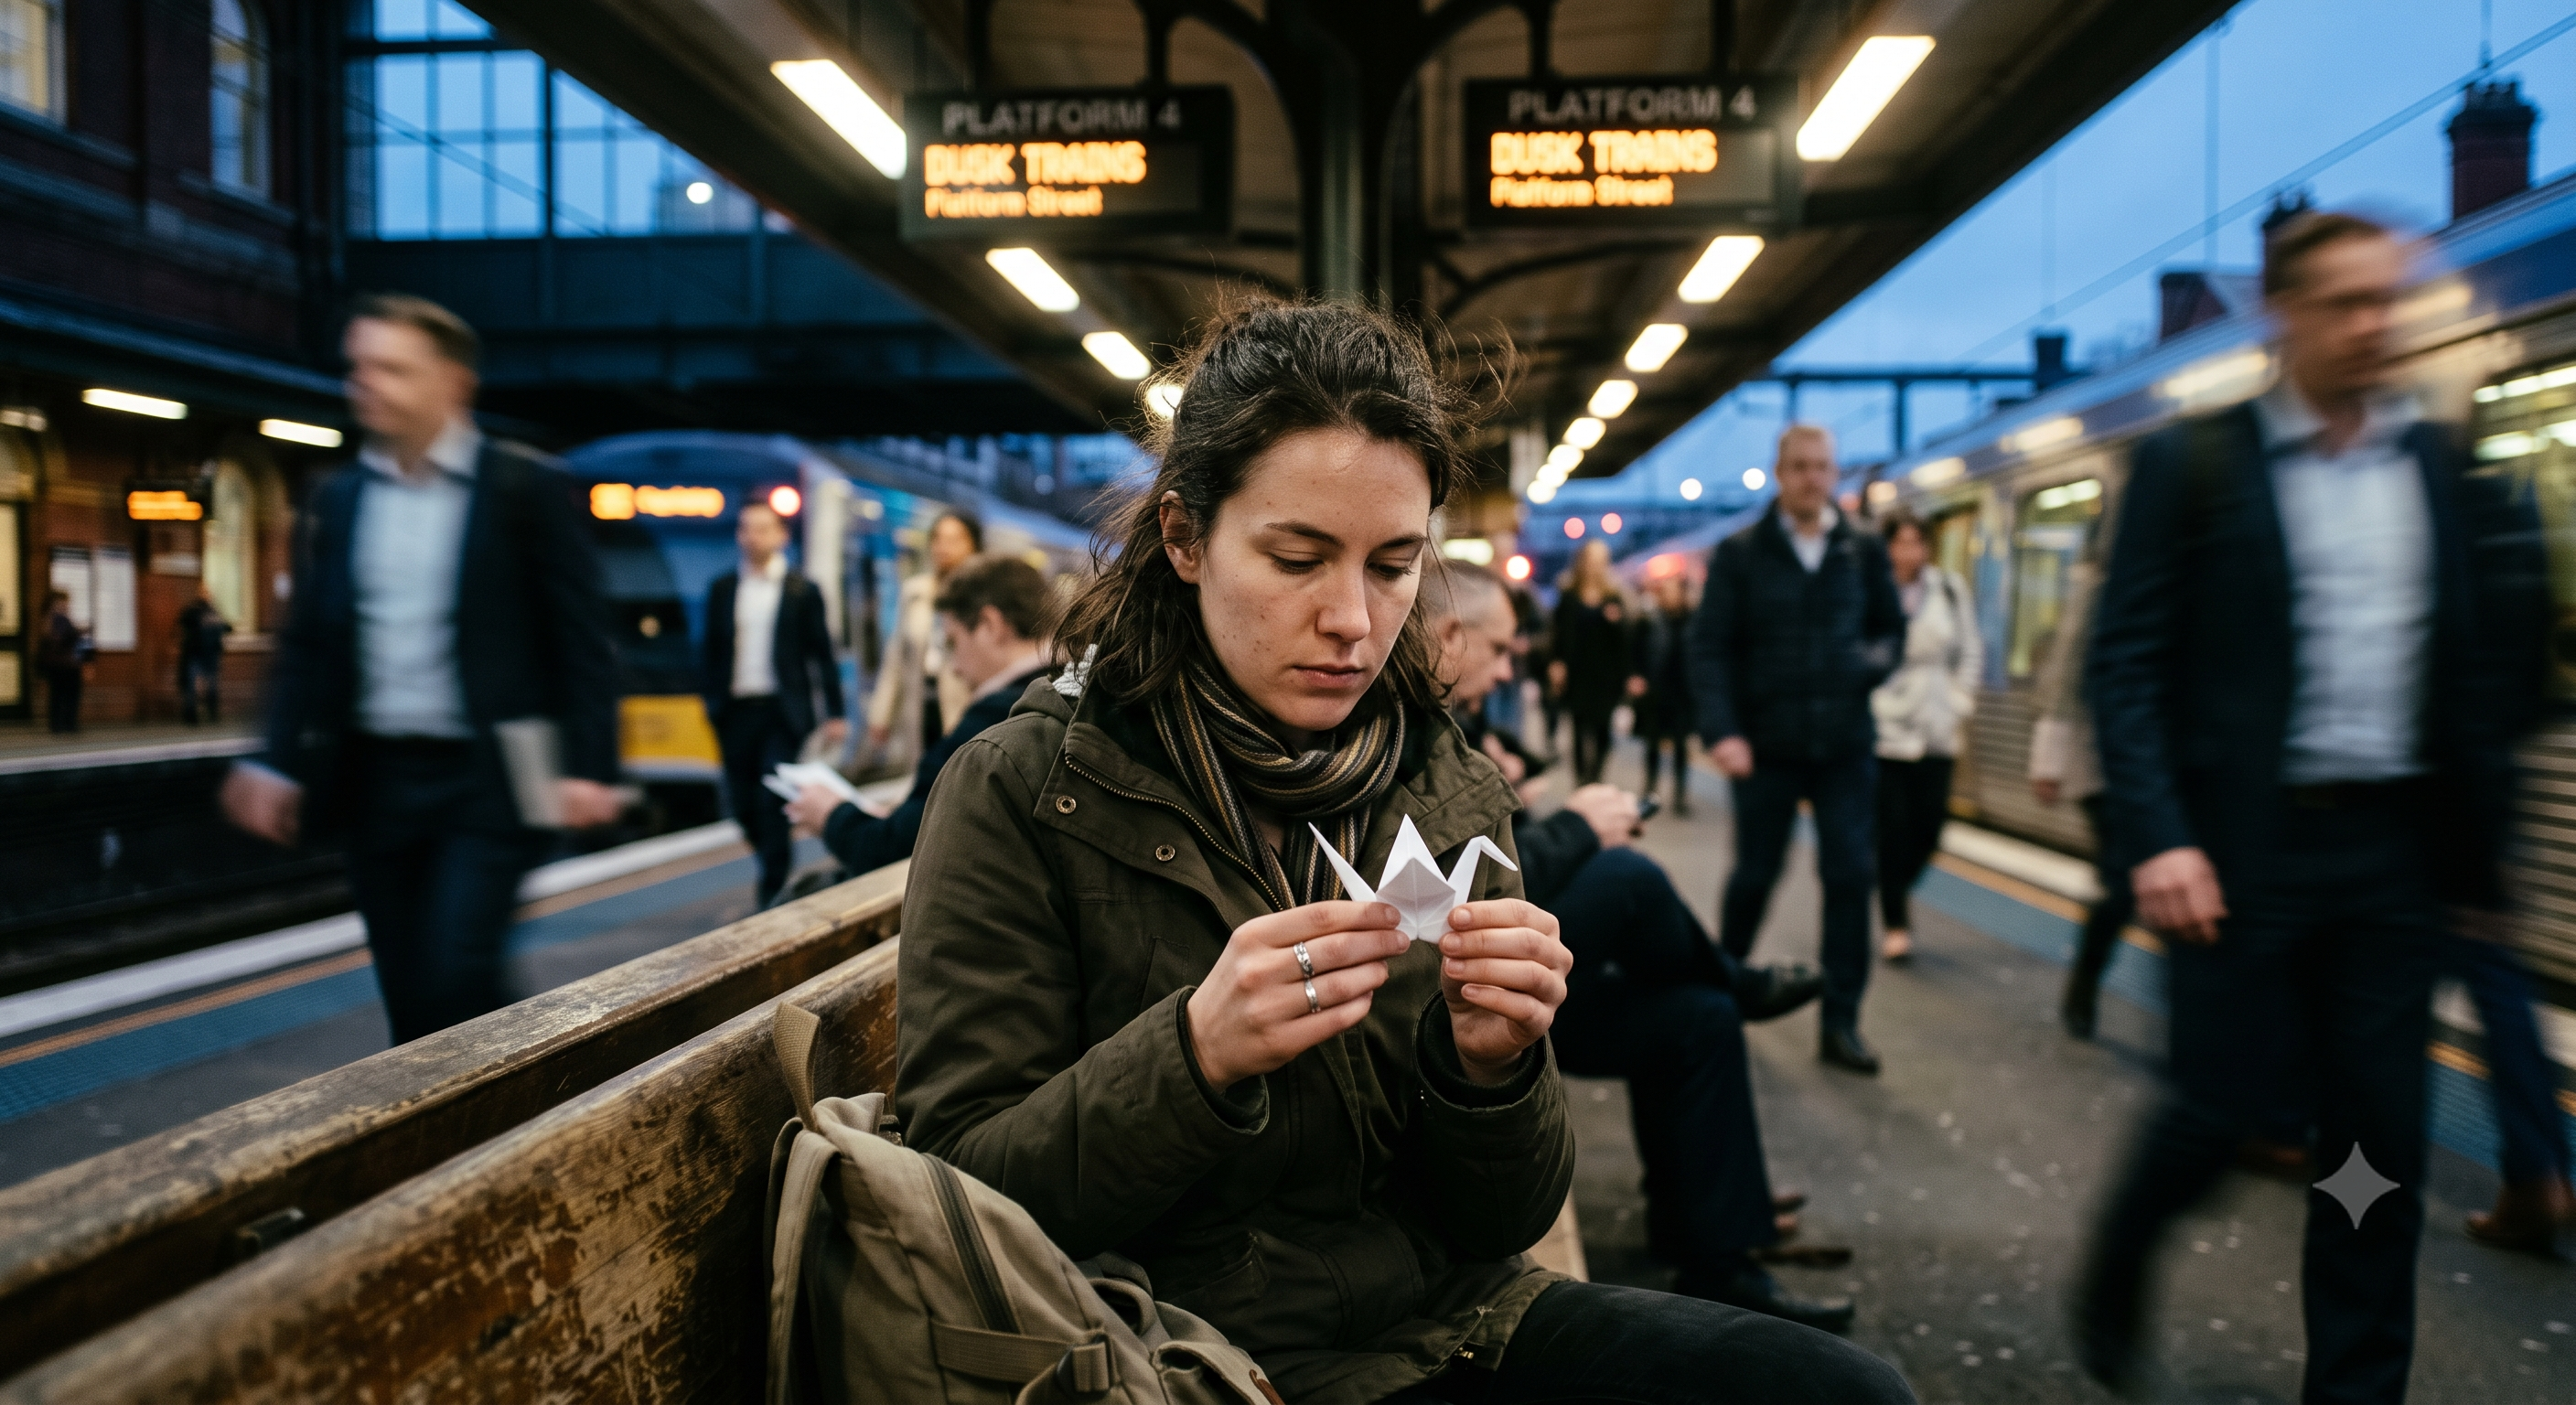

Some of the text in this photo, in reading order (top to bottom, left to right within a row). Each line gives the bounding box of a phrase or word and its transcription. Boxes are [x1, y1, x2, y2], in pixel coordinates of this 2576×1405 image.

[942, 99, 1180, 135] PLATFORM 4
[1508, 86, 1755, 123] PLATFORM 4
[925, 141, 1146, 186] DUSK TRAINS
[1491, 129, 1718, 175] DUSK TRAINS
